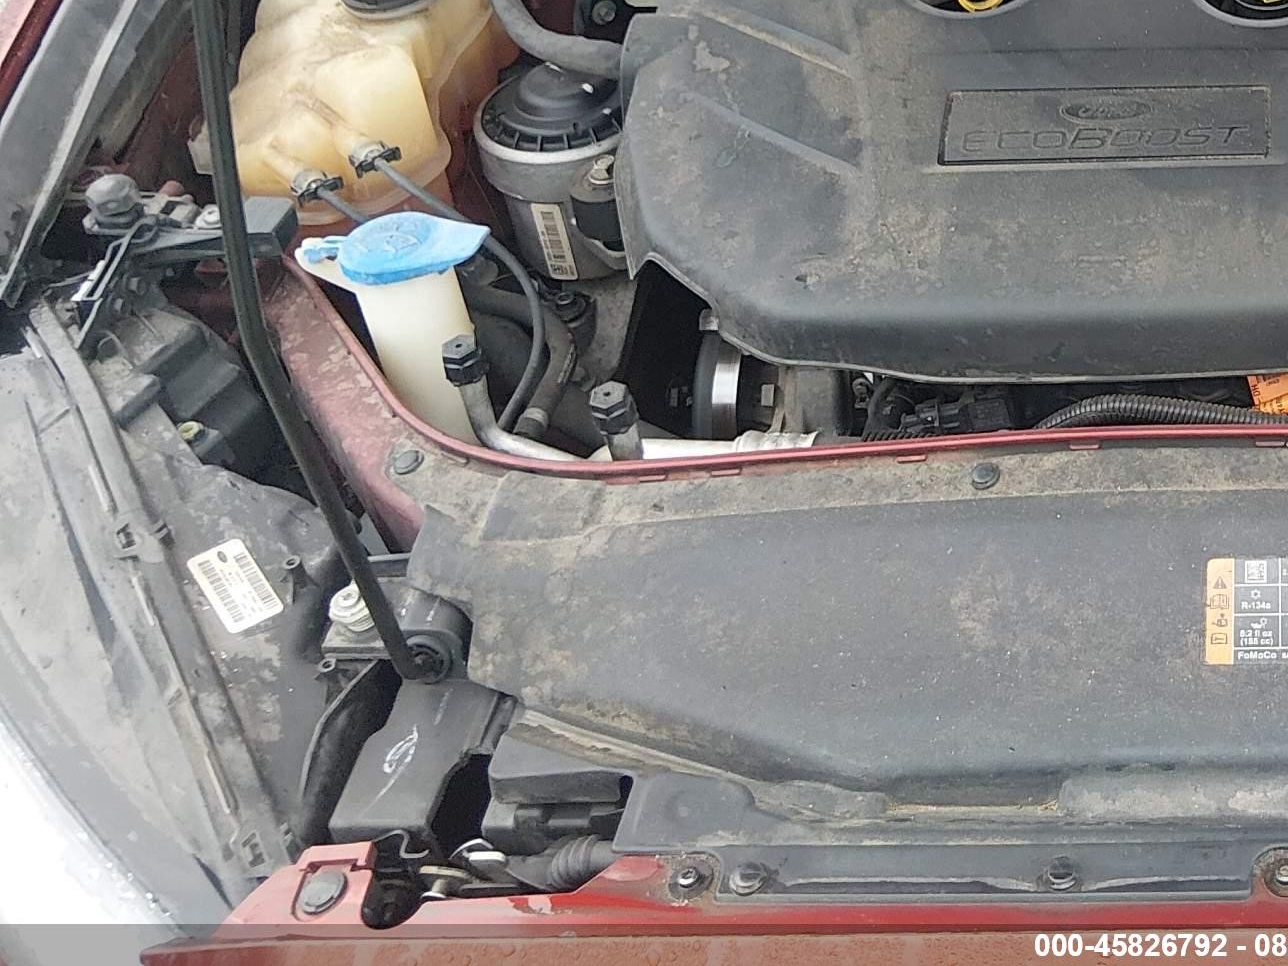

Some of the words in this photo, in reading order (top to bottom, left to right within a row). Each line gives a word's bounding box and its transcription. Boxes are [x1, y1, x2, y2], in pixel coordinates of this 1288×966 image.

[1241, 601, 1271, 610] R-134a
[1260, 637, 1274, 646] cc)
[1237, 651, 1277, 659] FoMoCo
